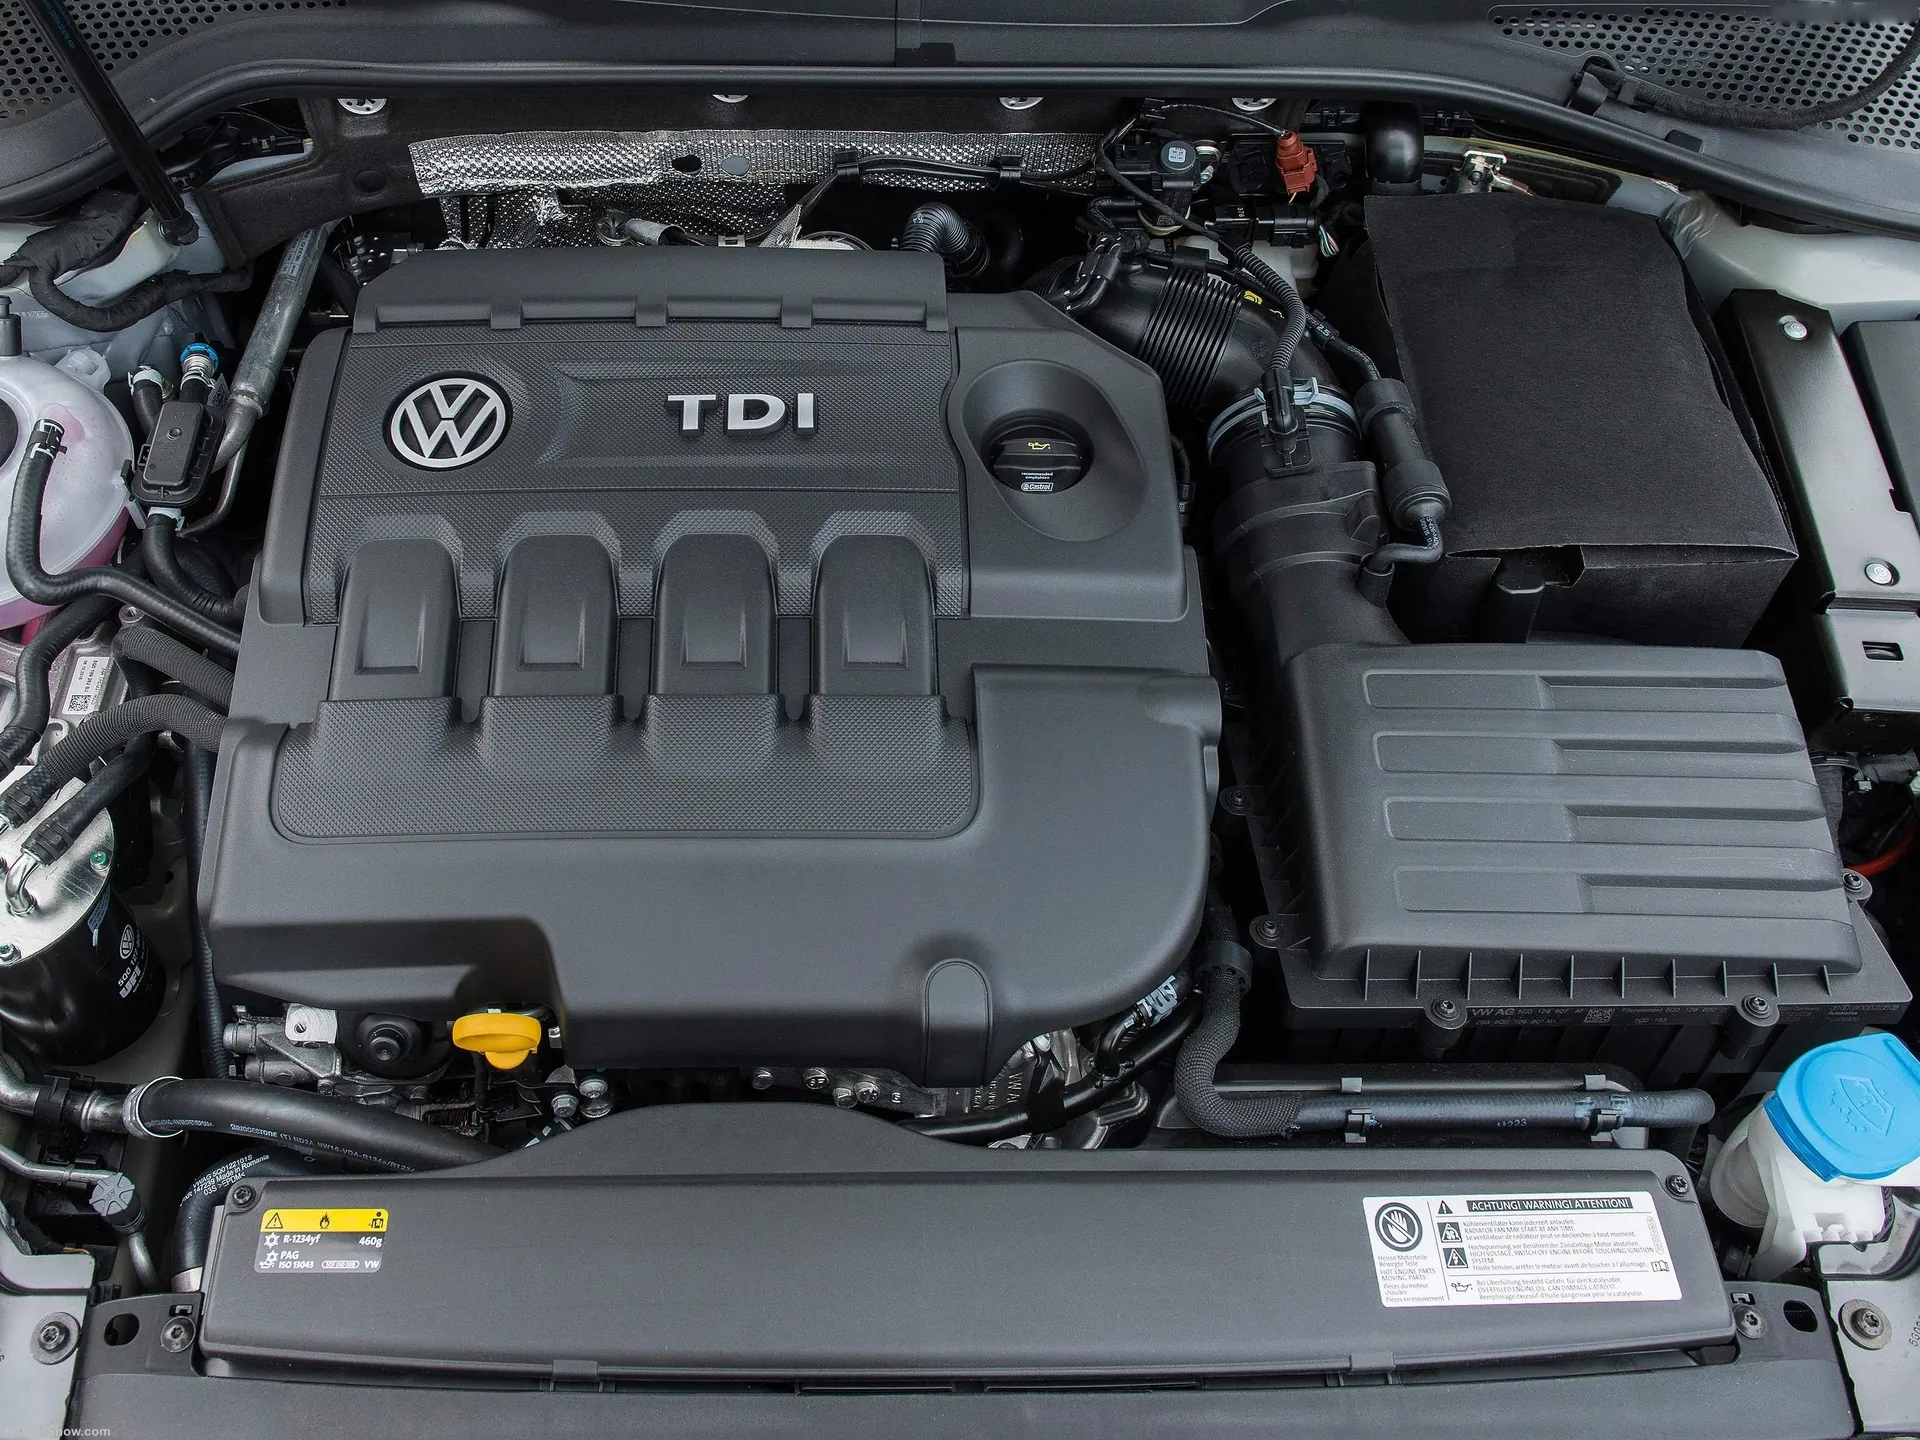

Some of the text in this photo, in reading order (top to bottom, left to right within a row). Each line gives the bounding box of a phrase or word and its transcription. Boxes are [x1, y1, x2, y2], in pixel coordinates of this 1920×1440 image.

[667, 393, 814, 430] TDI
[390, 378, 506, 468] VW
[119, 965, 141, 998] UFI
[1471, 1008, 1493, 1016] VW
[1496, 1008, 1515, 1016] AG
[215, 1170, 234, 1183] Made
[241, 1154, 270, 1170] Romania
[203, 1185, 218, 1196] 03S
[1471, 1198, 1629, 1211] ACHTUNG! WARNING! ATTENTION!
[283, 1234, 383, 1248] R-1234yf 460g
[280, 1250, 300, 1260] PAG
[278, 1261, 315, 1269] ISO 13043
[364, 1260, 380, 1269] VW
